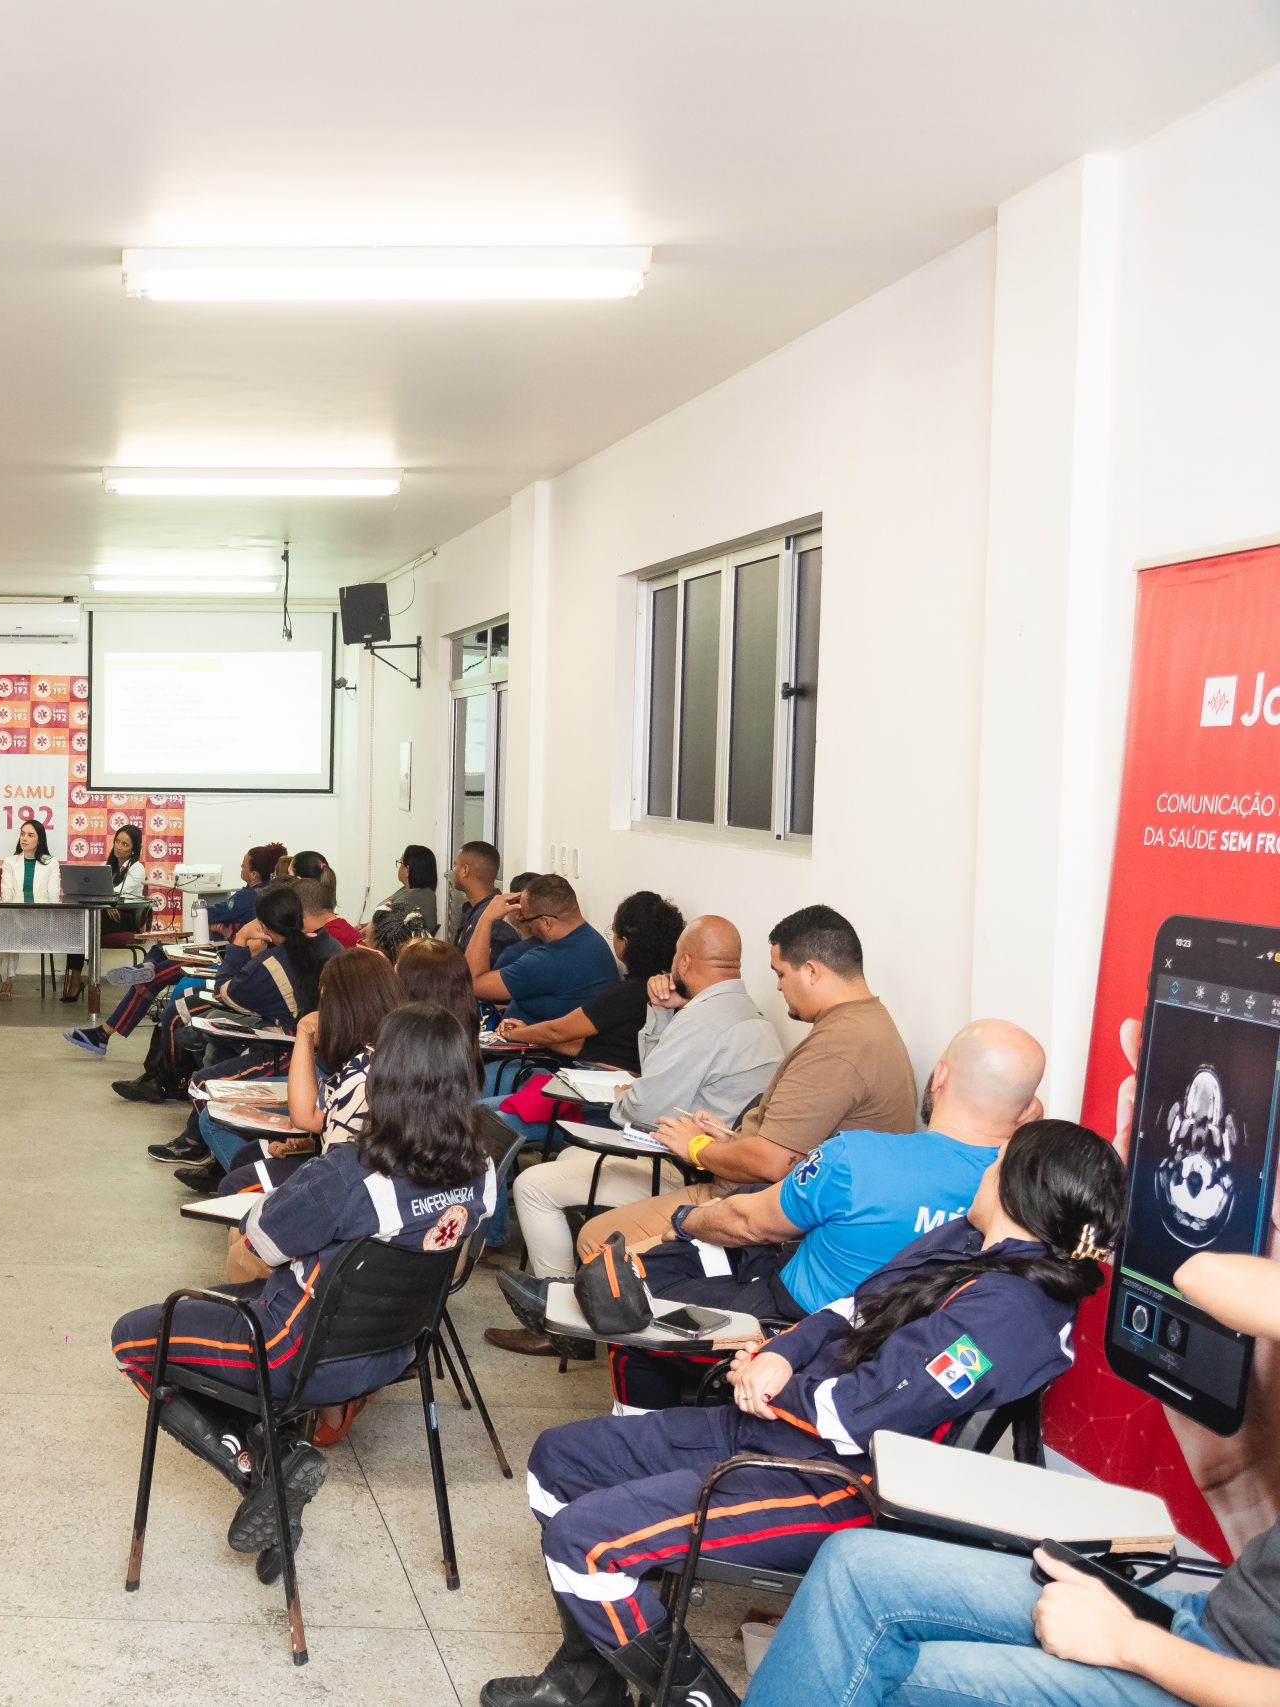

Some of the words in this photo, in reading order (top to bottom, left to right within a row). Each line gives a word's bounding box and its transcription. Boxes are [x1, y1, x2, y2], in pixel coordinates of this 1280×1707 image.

[14, 686, 27, 694] 192
[53, 687, 67, 695] 192
[53, 713, 67, 721] 192
[52, 740, 66, 748] 192
[4, 785, 55, 799] SAMU
[1156, 792, 1275, 818] COMUNICAÇÃO
[3, 806, 54, 830] 192
[1144, 827, 1164, 846] DA
[1168, 826, 1218, 850] SAÚDE
[1219, 831, 1252, 853] SEM
[1175, 938, 1191, 948] 10:23
[411, 1187, 474, 1216] ENFERMEIRA
